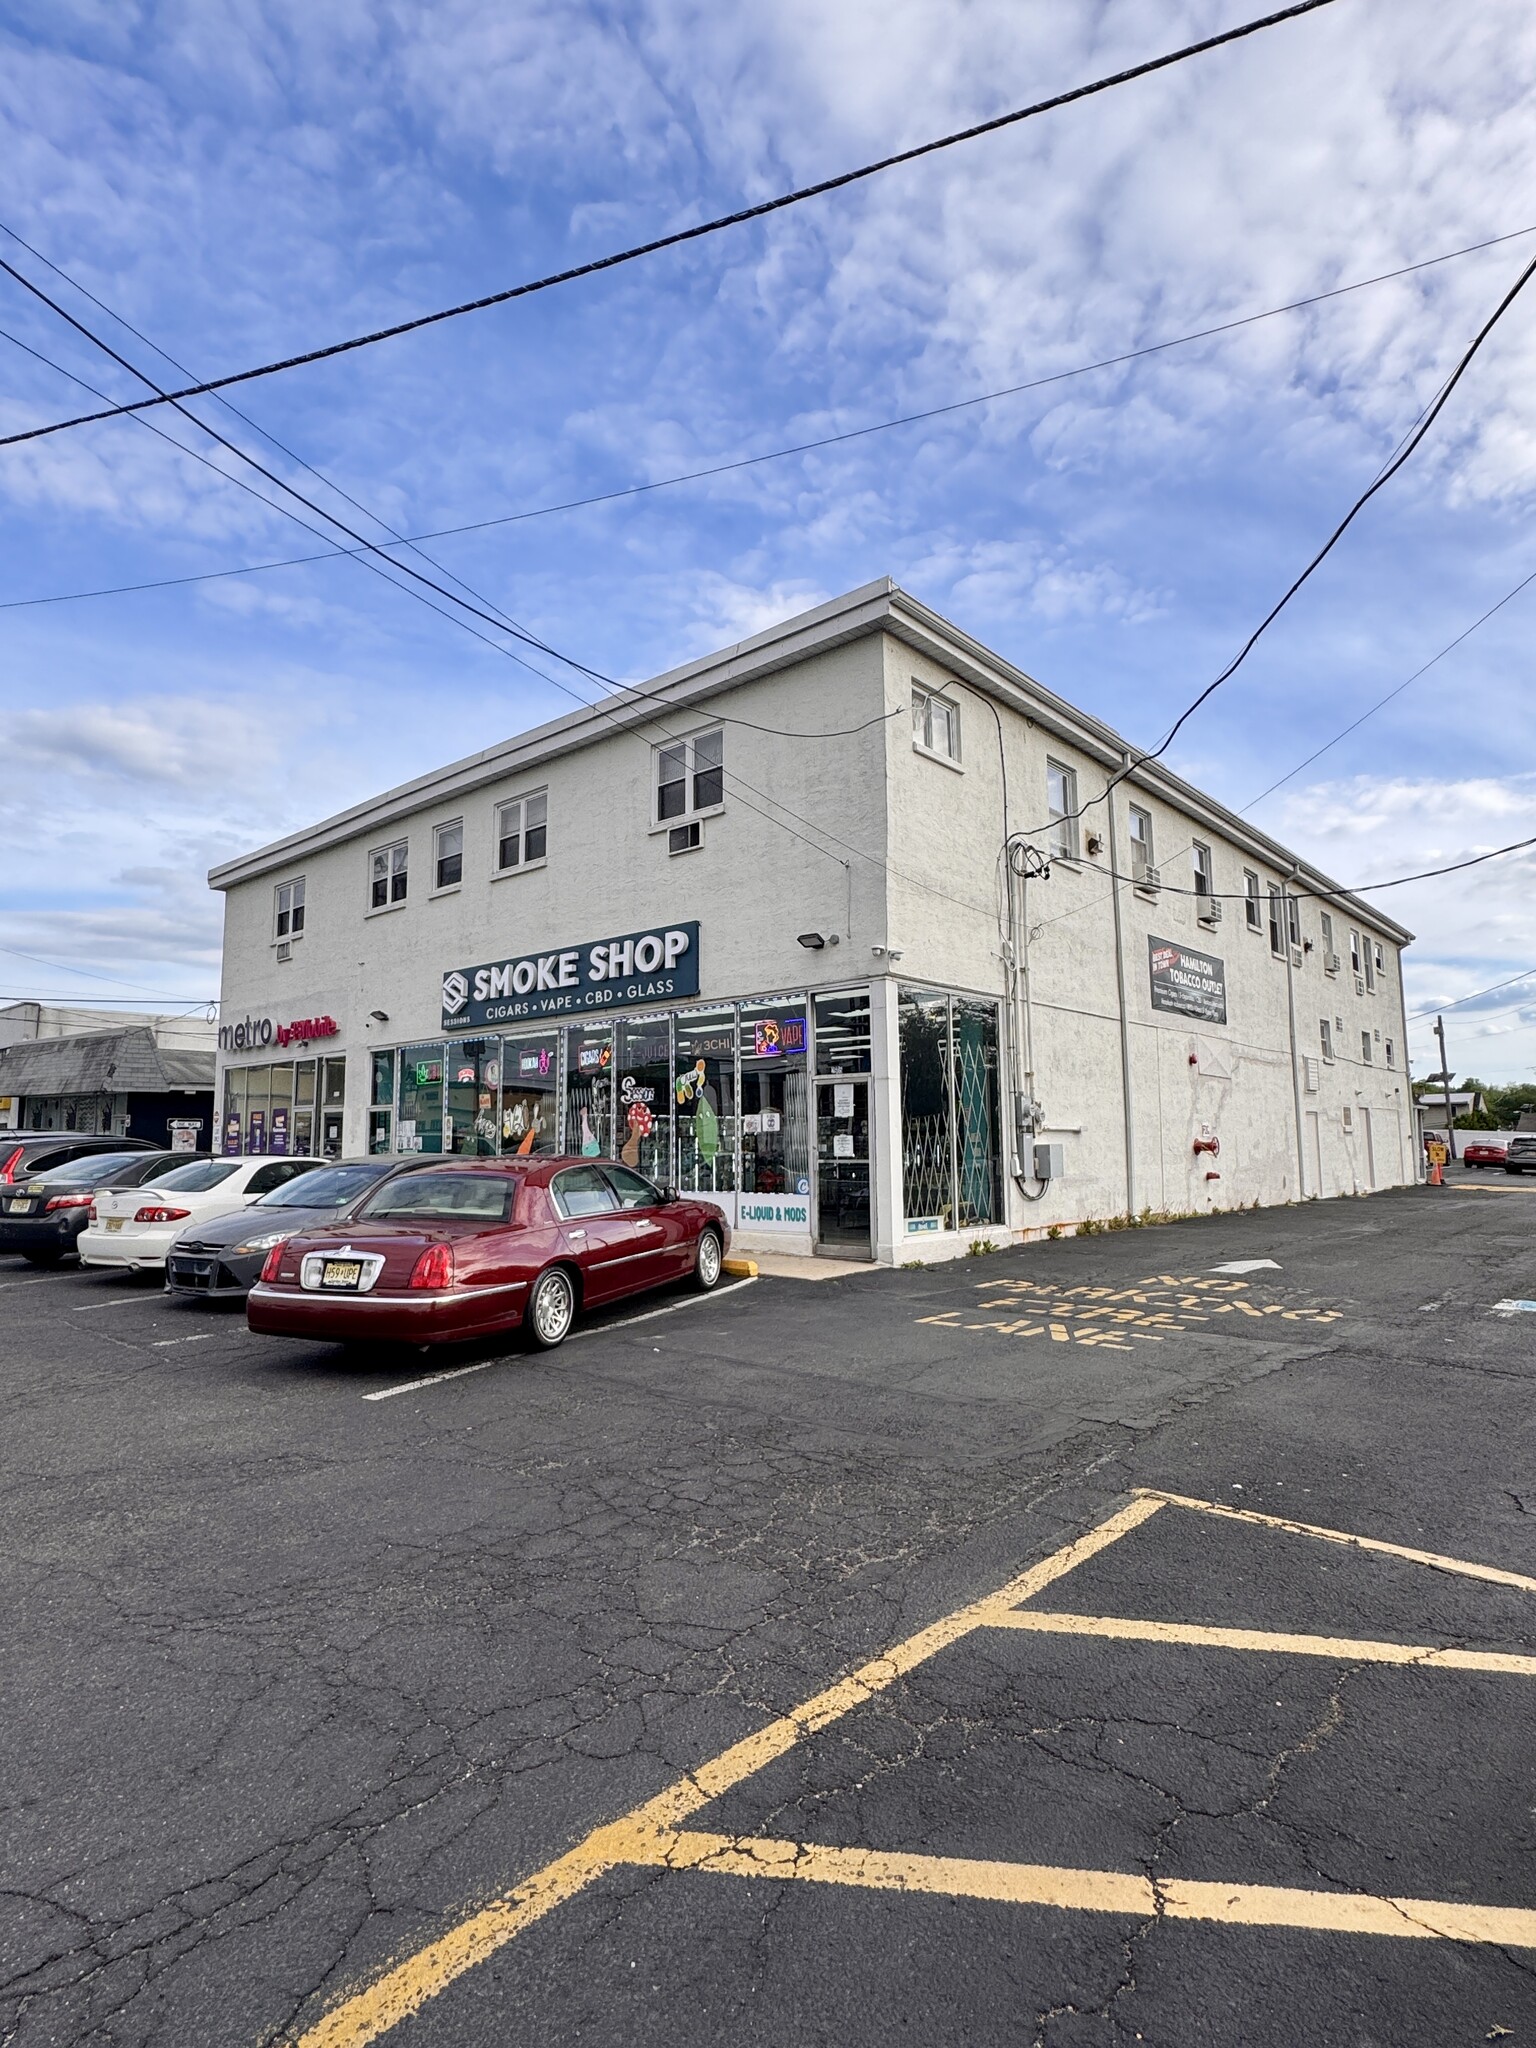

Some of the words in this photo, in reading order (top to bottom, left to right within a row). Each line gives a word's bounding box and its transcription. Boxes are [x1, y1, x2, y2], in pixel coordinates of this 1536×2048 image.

[473, 951, 579, 1001] SMOKE
[588, 931, 690, 981] SHOP
[1180, 953, 1213, 976] HAMILTON
[1170, 968, 1201, 989] TOBACCO
[1202, 978, 1223, 995] OUTLET
[486, 1002, 529, 1020] CIGARS
[540, 995, 573, 1011] VAPE
[585, 989, 613, 1008] CBD
[627, 979, 674, 999] GLASS
[219, 1015, 273, 1050] metro
[443, 1015, 471, 1026] SESSIONS
[703, 1038, 730, 1050] 3CHI
[781, 1025, 803, 1046] VAPE
[741, 1205, 774, 1221] E-LIQUID
[776, 1207, 782, 1221] &
[784, 1207, 807, 1222] MODS
[1137, 1275, 1249, 1291] NO
[974, 1279, 1344, 1322] PARKING
[977, 1297, 1210, 1330] FIRE
[913, 1311, 1164, 1350] LANE
